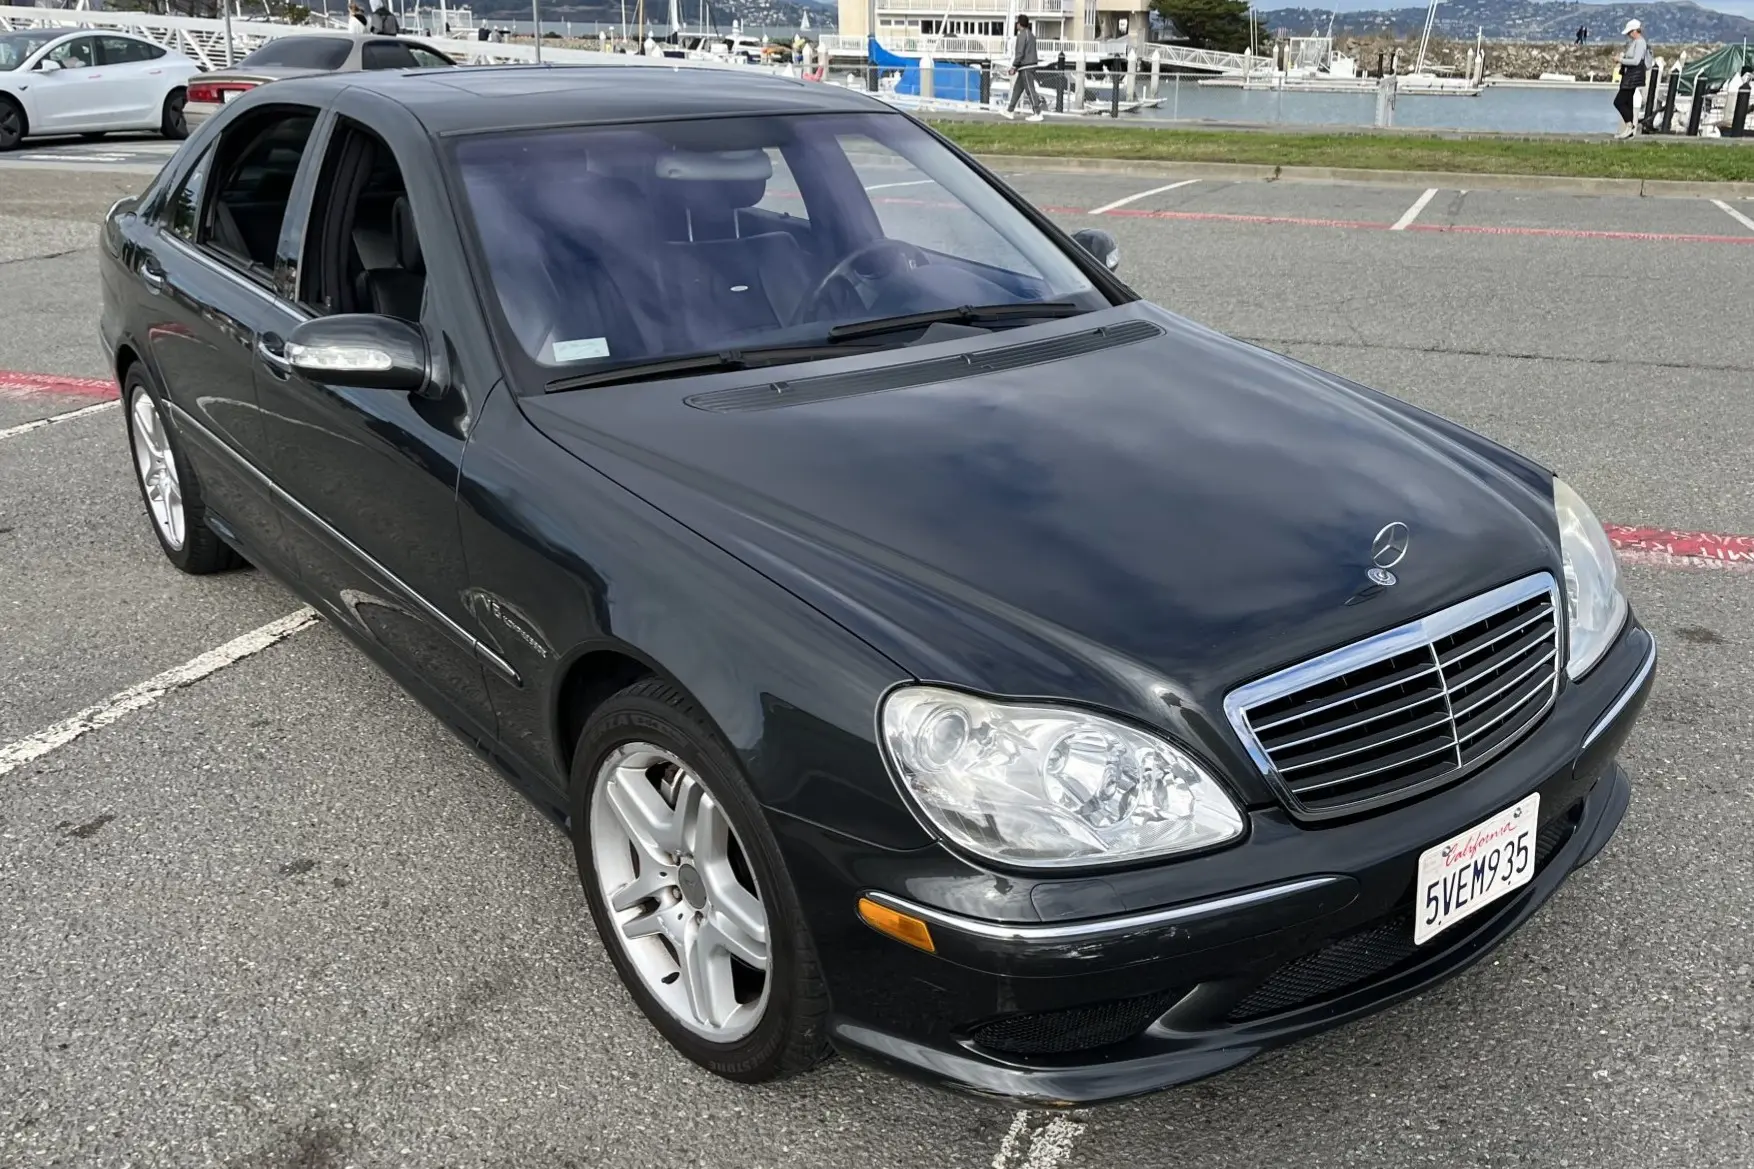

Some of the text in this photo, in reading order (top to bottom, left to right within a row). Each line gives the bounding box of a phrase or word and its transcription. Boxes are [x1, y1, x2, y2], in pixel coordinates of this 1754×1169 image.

[1445, 821, 1517, 867] California
[1426, 831, 1529, 925] 5VEM935
[708, 1017, 784, 1073] IDGESTONE
